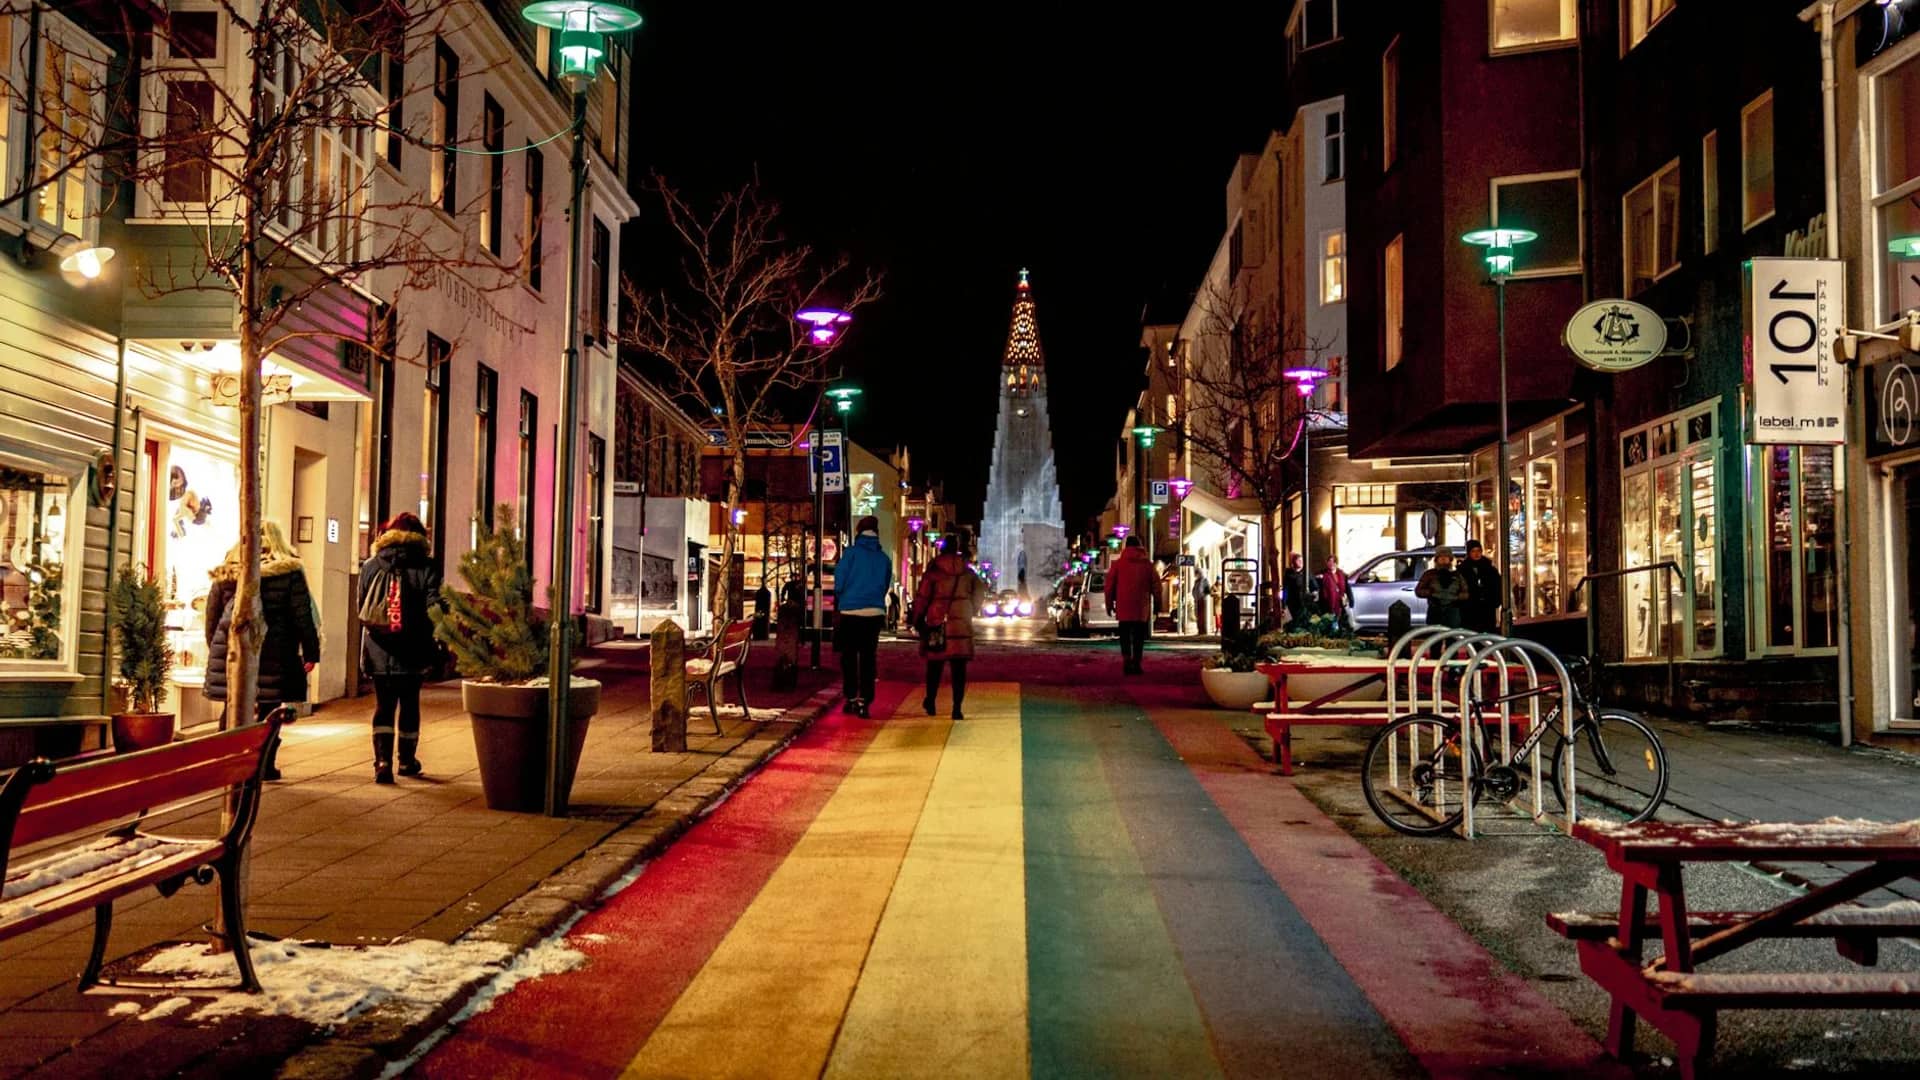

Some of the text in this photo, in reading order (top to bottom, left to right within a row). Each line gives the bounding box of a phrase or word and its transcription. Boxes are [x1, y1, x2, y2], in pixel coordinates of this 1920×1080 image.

[1769, 279, 1817, 385] 101
[1760, 416, 1816, 428] label.m
[1156, 484, 1163, 494] P
